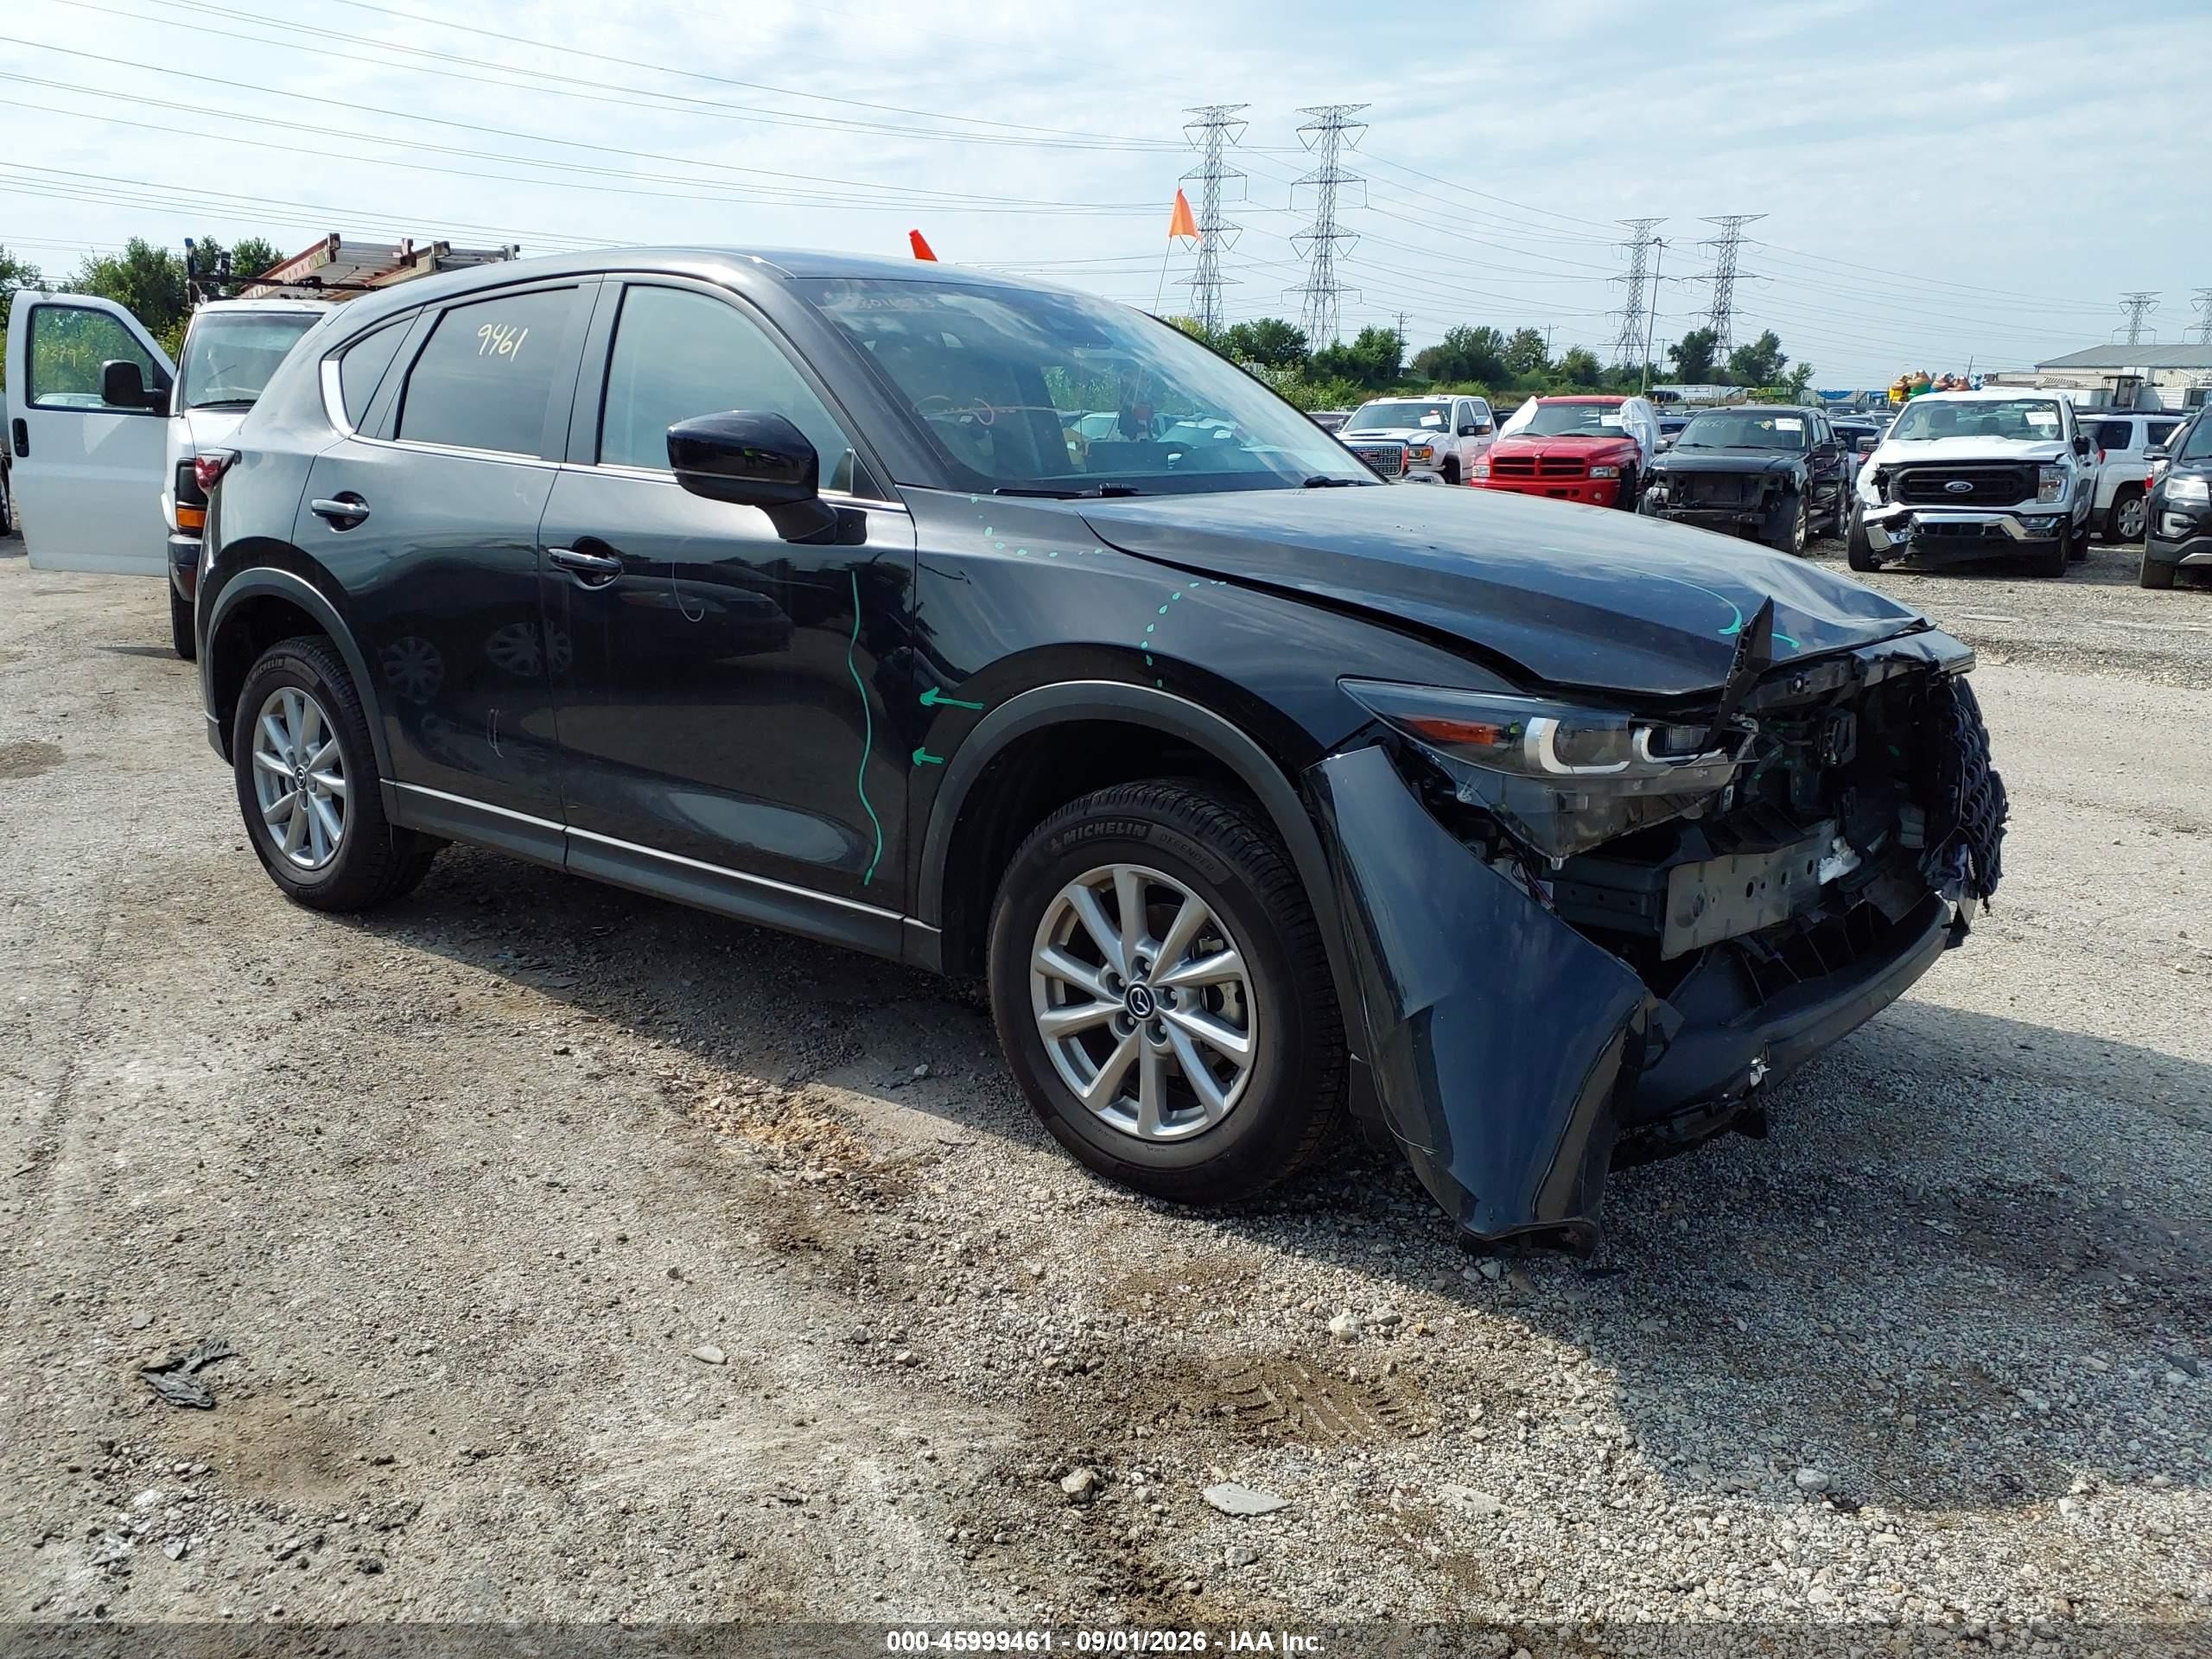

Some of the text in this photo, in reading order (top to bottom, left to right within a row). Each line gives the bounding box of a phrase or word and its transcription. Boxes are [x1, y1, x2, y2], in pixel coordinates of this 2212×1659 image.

[477, 323, 529, 362] 9461
[1064, 822, 1216, 872] MICHELIN DEFENDER
